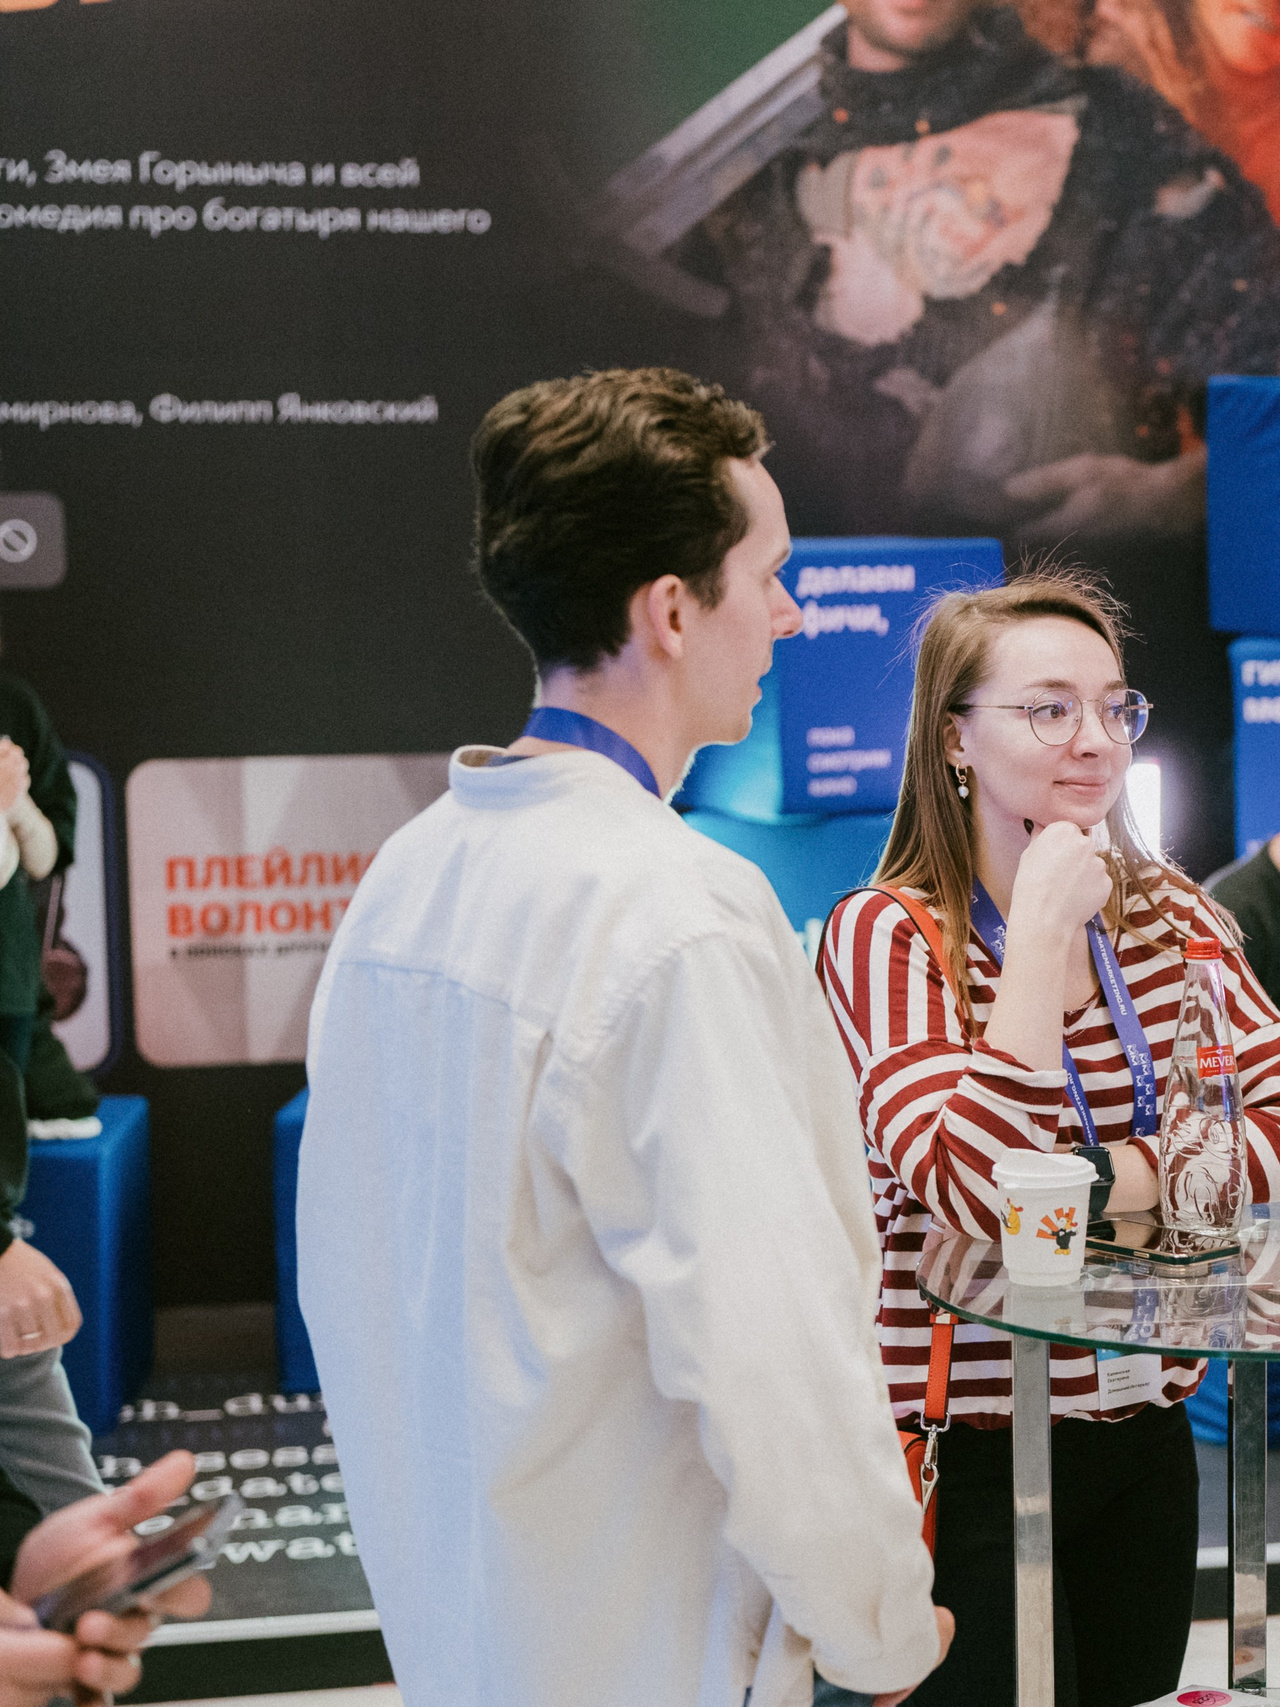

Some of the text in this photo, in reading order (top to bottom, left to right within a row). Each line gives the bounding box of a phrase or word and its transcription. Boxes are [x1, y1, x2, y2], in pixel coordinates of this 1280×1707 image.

[44, 149, 131, 184] Змея
[138, 150, 306, 193] Горыныча
[312, 162, 335, 187] и
[341, 157, 420, 188] всей
[129, 204, 197, 239] про
[202, 196, 361, 241] богатыря
[366, 207, 492, 234] нашего
[149, 392, 273, 424] Филипп
[277, 391, 438, 424] Янковский
[795, 564, 916, 599] делаем
[1199, 1054, 1235, 1069] MEVER
